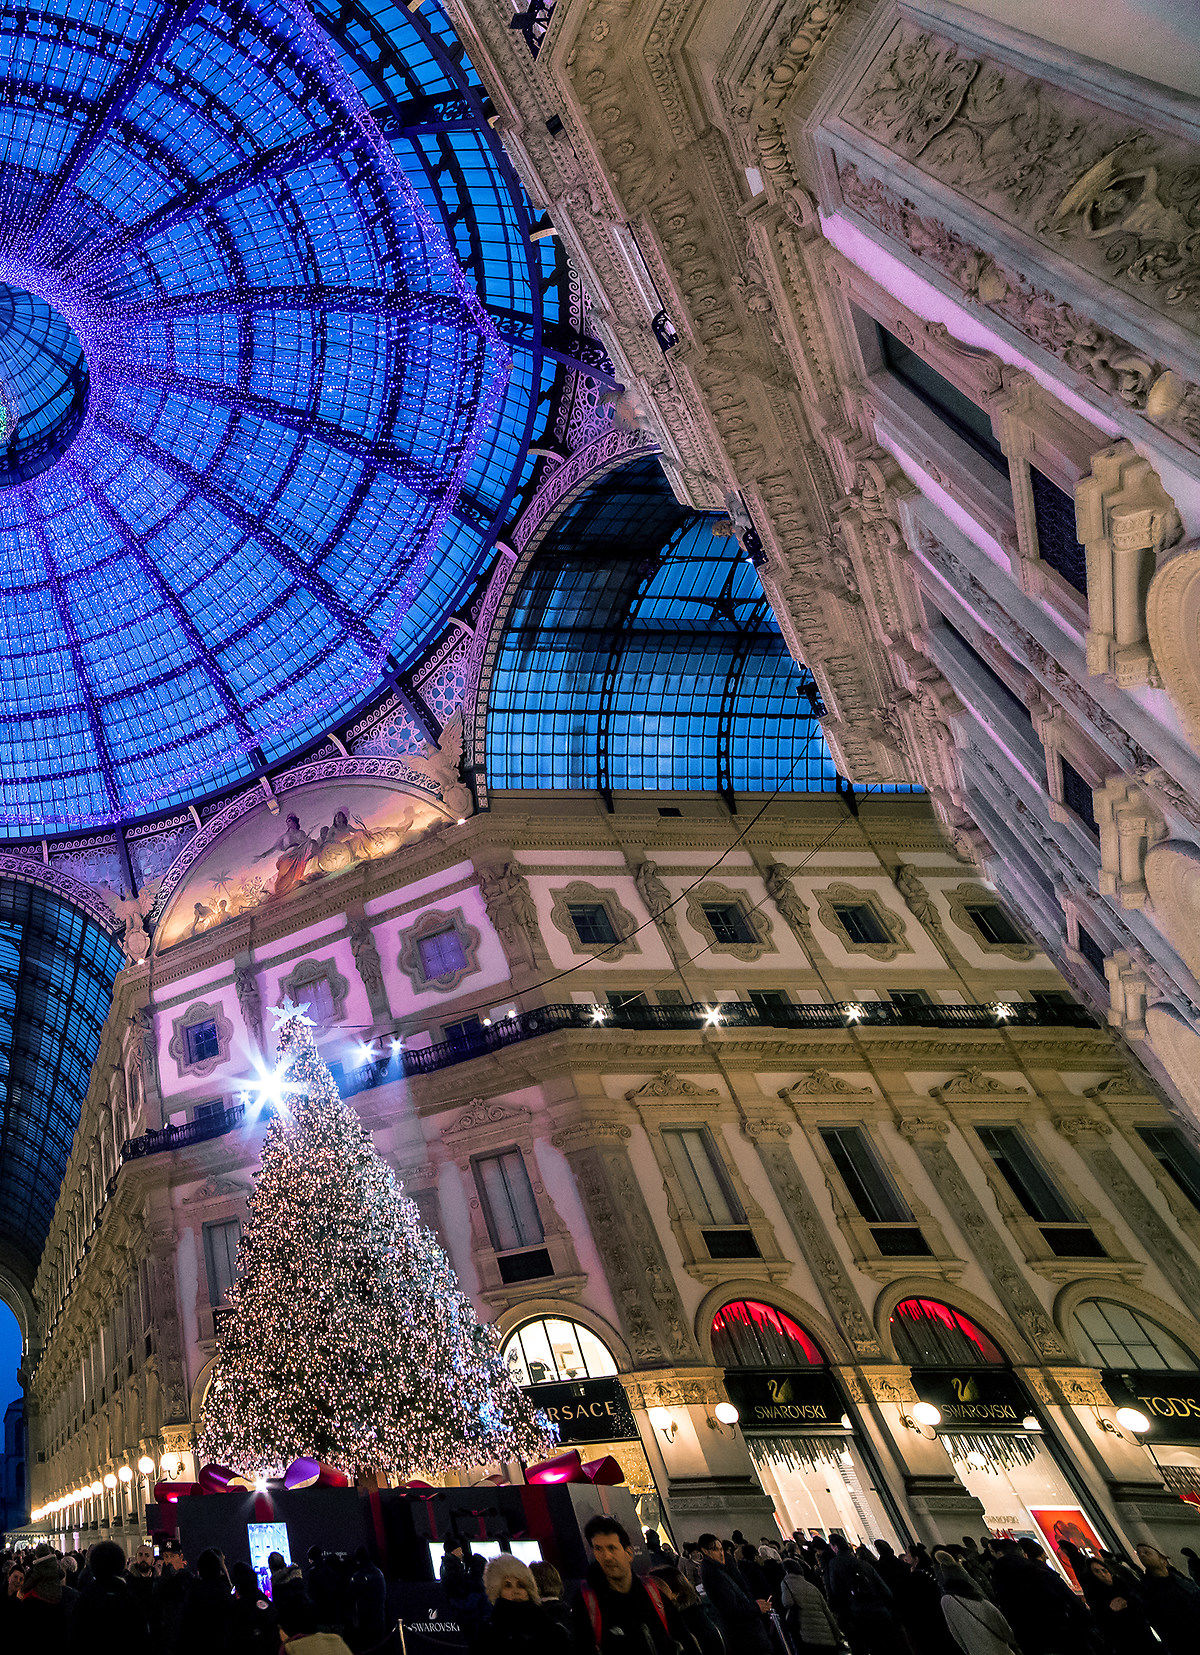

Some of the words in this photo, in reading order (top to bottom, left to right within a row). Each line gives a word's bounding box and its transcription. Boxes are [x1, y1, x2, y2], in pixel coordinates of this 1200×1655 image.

[546, 1401, 617, 1421] RSACE
[754, 1405, 827, 1419] SWAROVSKI
[941, 1404, 1017, 1419] SWAROVSKI
[1138, 1397, 1200, 1417] TOD'S
[410, 1622, 460, 1632] SWAROVSKI
